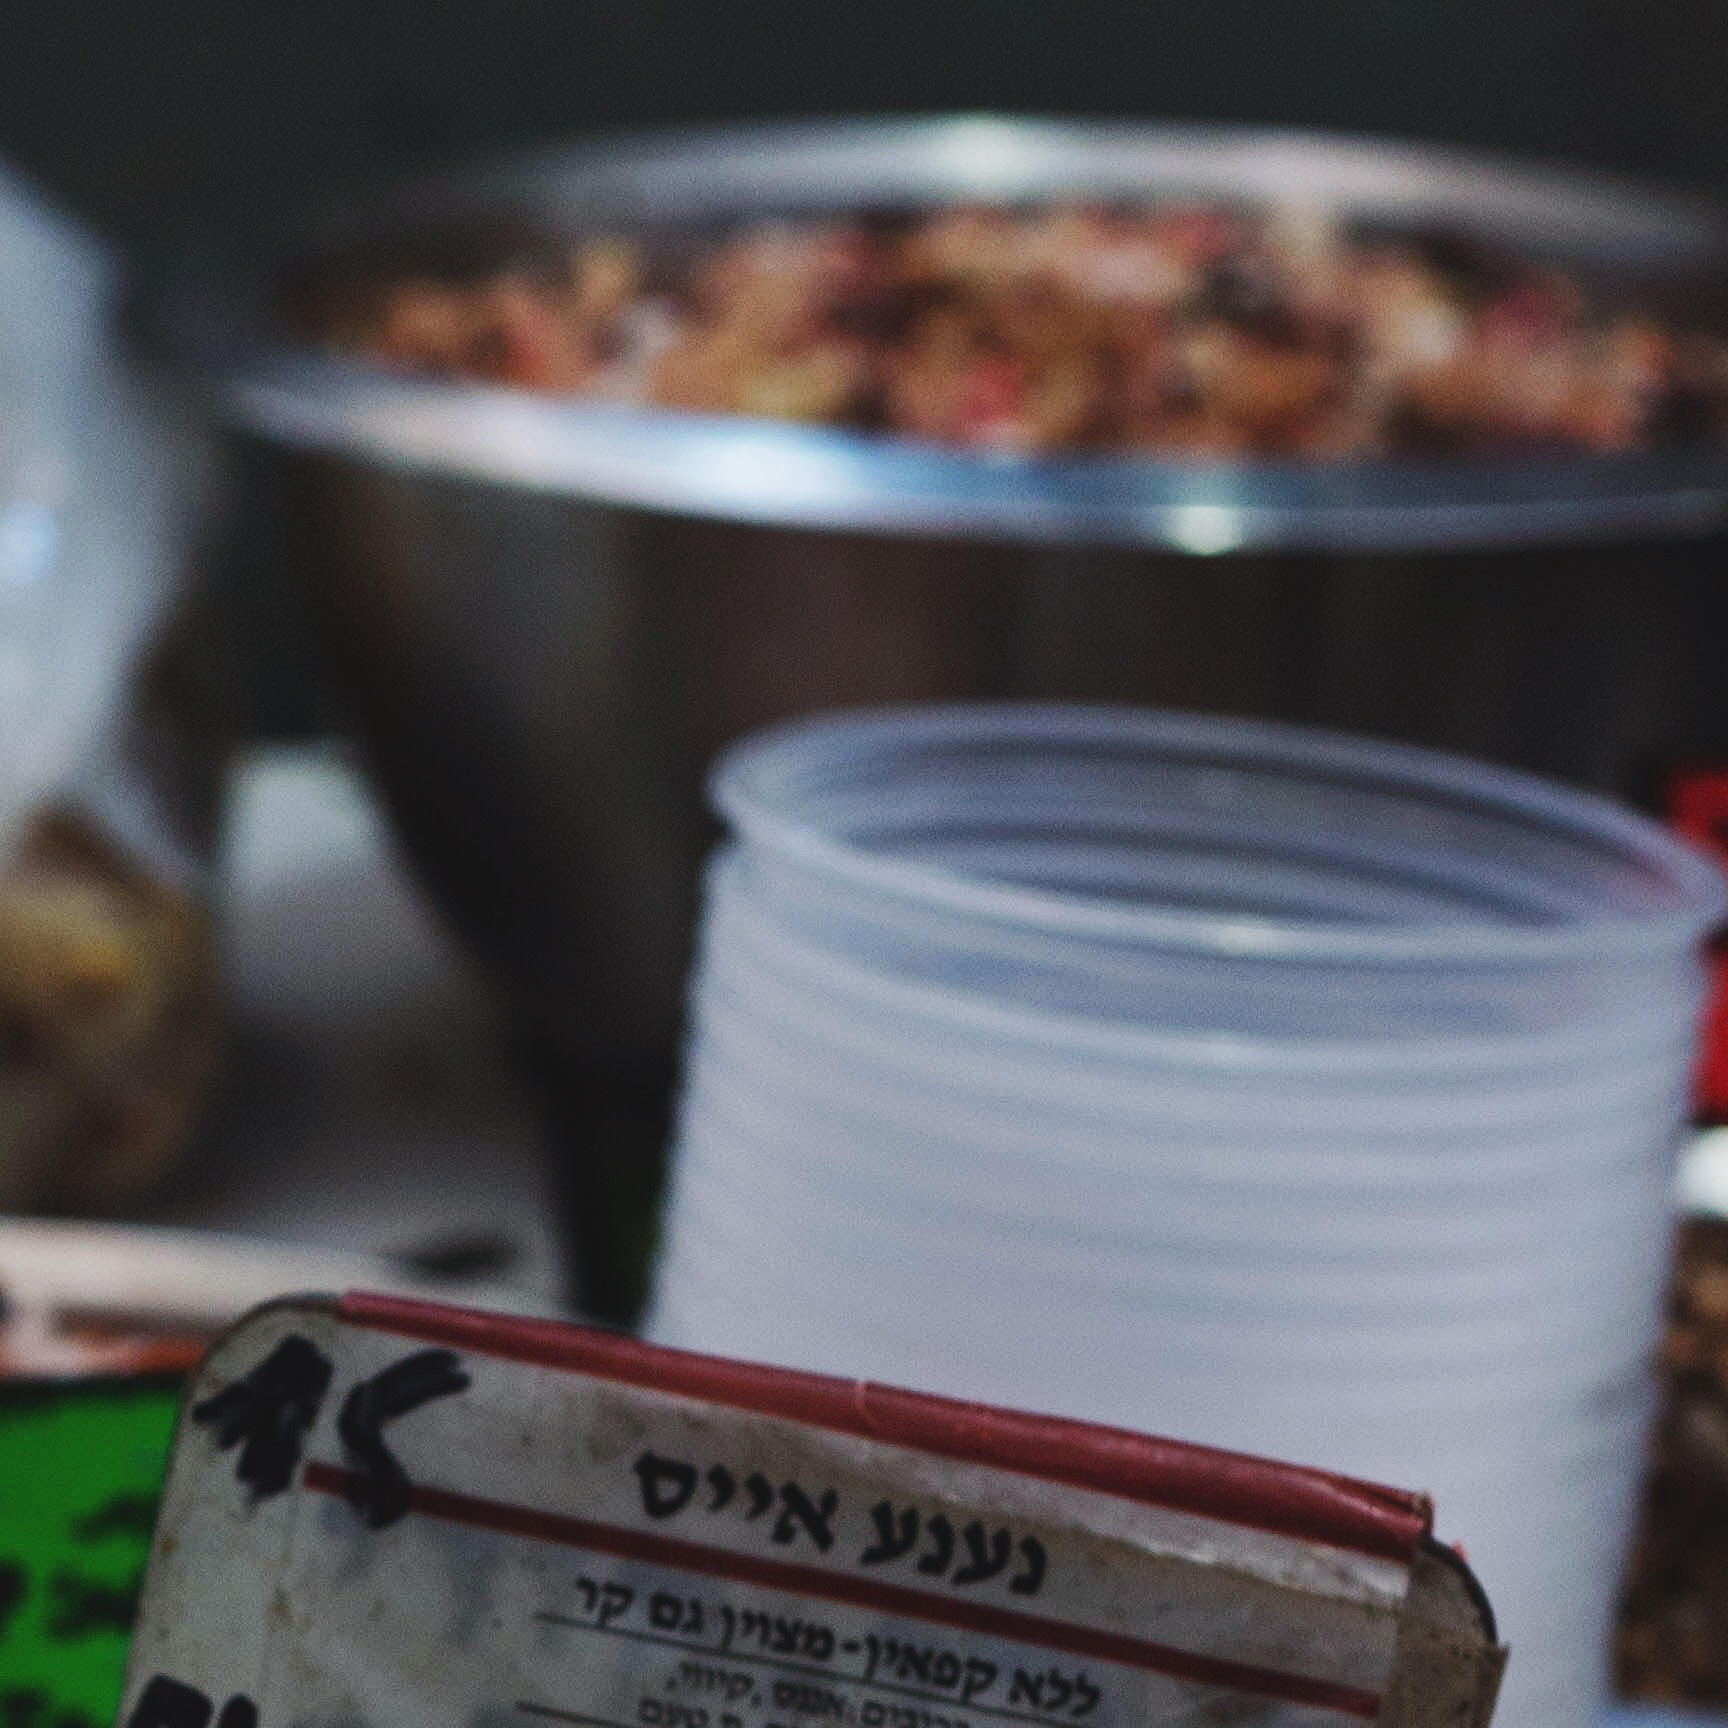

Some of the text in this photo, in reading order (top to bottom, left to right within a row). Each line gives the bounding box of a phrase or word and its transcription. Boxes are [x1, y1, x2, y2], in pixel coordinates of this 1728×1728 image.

[633, 1449, 1049, 1595] נענע אייס
[573, 1576, 635, 1629] קר
[648, 1591, 704, 1633] גם
[1008, 1668, 1101, 1718] ללא
